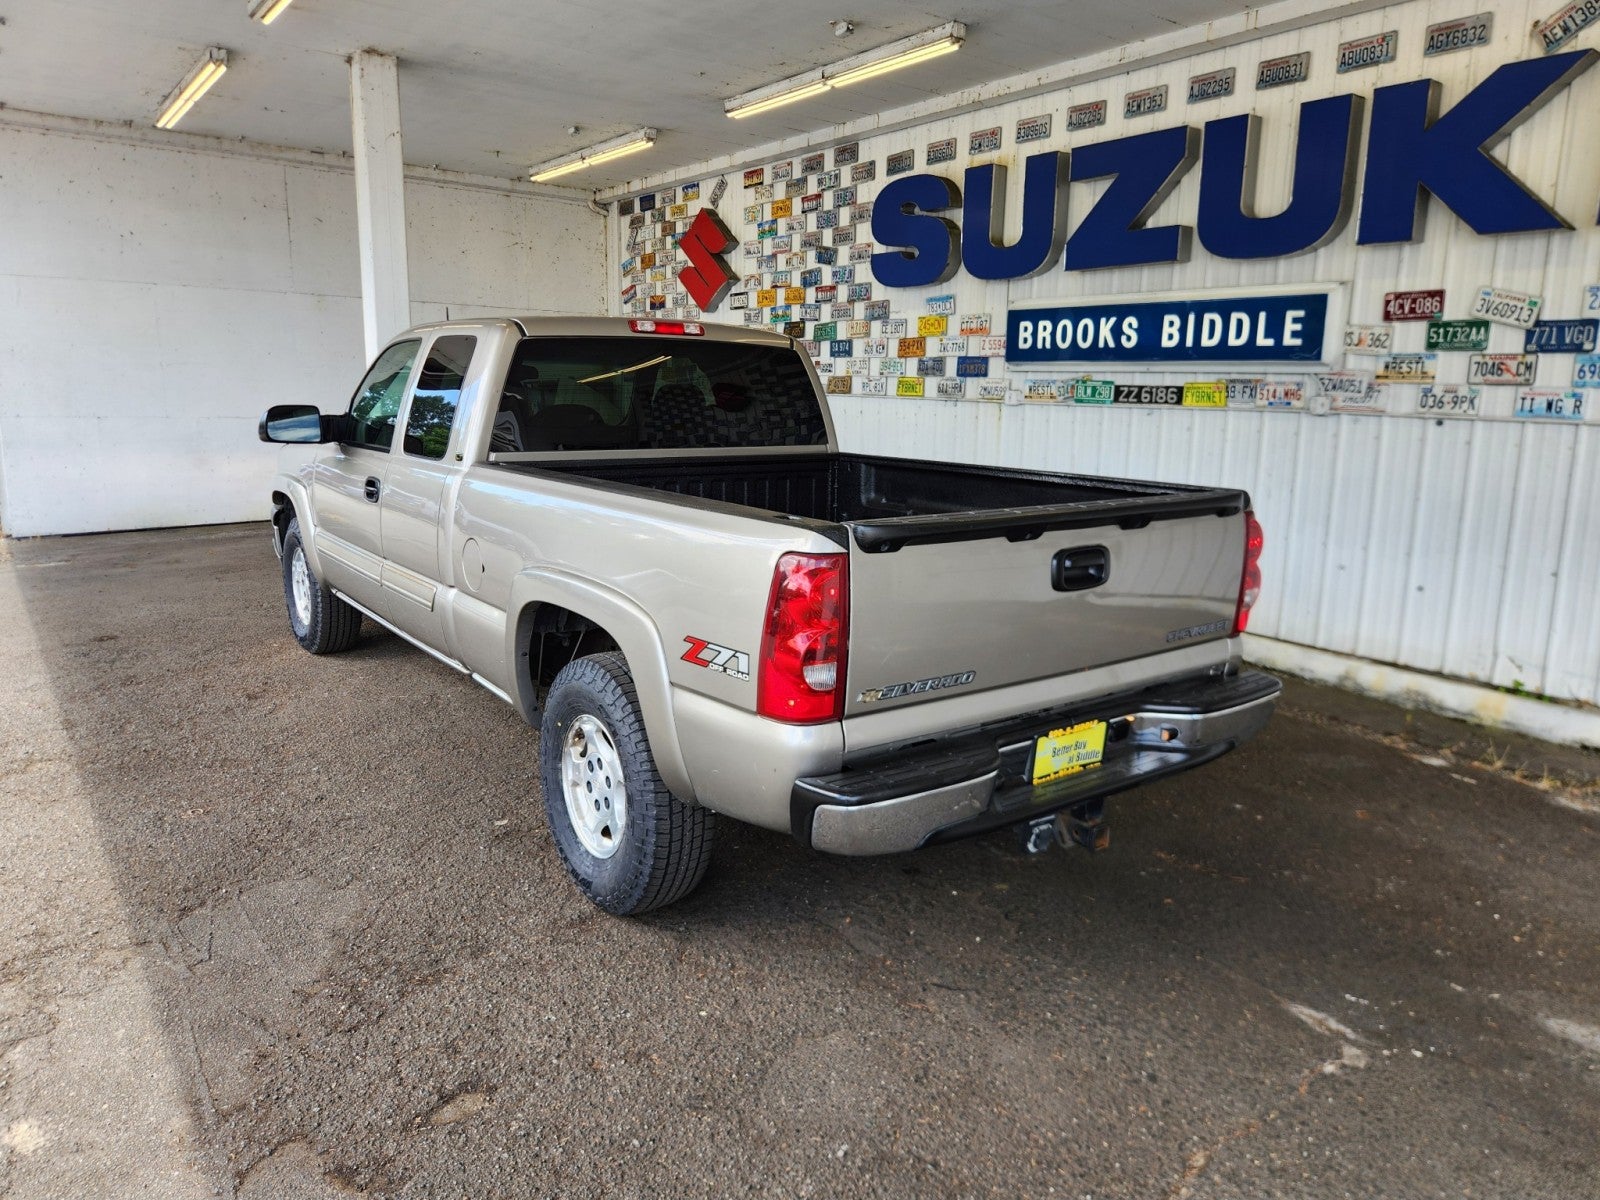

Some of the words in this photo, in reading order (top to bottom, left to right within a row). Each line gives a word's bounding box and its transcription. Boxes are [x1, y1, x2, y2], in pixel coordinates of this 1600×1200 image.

[1426, 24, 1486, 52] AGY6832
[1339, 42, 1390, 68] ABU0831
[1257, 62, 1304, 85] ABU0831
[871, 48, 1600, 288] SUZUK
[1475, 298, 1534, 323] 3V60913
[1018, 316, 1138, 349] BROOKS
[1160, 310, 1306, 348] BIDDLE
[1429, 326, 1486, 343] 51732AA
[1530, 327, 1557, 344] 771
[1367, 332, 1390, 349] 362
[1383, 360, 1428, 375] WRESTL
[1473, 362, 1504, 378] 7046
[1516, 361, 1533, 377] CM
[1118, 387, 1139, 403] ZZ
[1140, 388, 1178, 404] 6186
[1184, 390, 1223, 404] FYBRNET
[680, 635, 750, 677] Z71
[709, 662, 724, 674] OFF
[726, 667, 749, 682] ROAD
[881, 670, 977, 700] SILVERADO
[1051, 744, 1073, 758] Better
[1073, 740, 1088, 751] Buy
